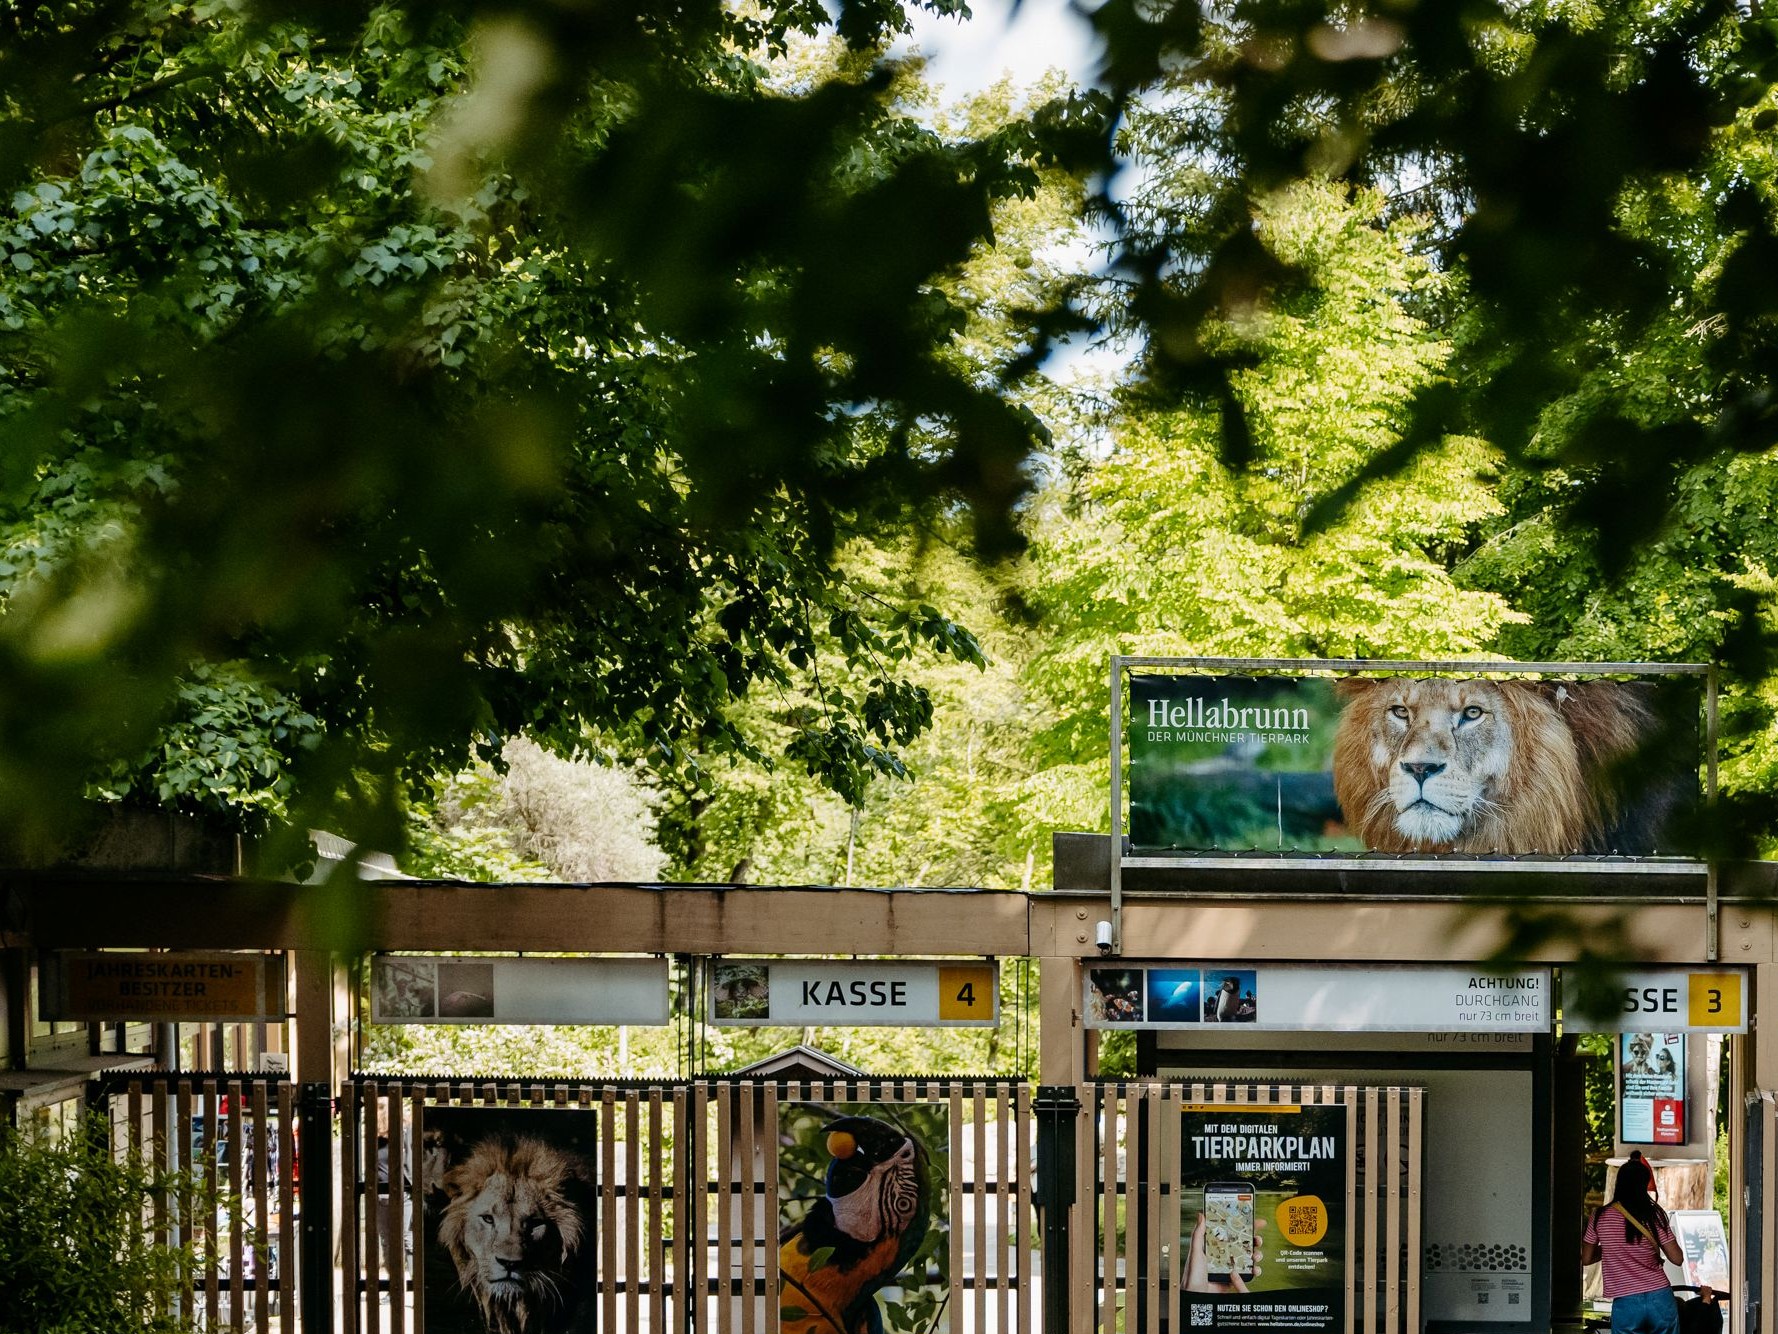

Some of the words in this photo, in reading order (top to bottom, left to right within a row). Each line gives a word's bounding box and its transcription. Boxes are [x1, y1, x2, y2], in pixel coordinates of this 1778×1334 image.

[1147, 697, 1310, 729] Hellabrunn
[1147, 731, 1171, 742] DER
[1176, 730, 1245, 743] MÜNCHNER
[1250, 732, 1310, 744] TIERPARK
[87, 962, 242, 979] JAHRESKARTEN-
[120, 981, 207, 996] BESITZER
[1468, 977, 1539, 989] ACHTUNG!
[802, 980, 907, 1006] KASSE
[956, 982, 976, 1007] 4
[1455, 994, 1539, 1007] DURCHGANG
[1603, 987, 1678, 1013] SSE
[1706, 989, 1722, 1013] 3
[1459, 1012, 1477, 1021] nur
[1479, 1011, 1492, 1021] 73
[1495, 1012, 1511, 1021] cm
[1514, 1011, 1539, 1021] breit
[1204, 1124, 1218, 1133] MIT
[1221, 1124, 1237, 1133] DEM
[1239, 1124, 1278, 1134] DIGITALEN
[1191, 1136, 1335, 1159] TIERPARKPLAN
[1235, 1161, 1261, 1171] IMMER
[1263, 1161, 1311, 1171] INFORMIERT!
[1217, 1304, 1240, 1312] NUTZEN
[1241, 1304, 1251, 1312] SIE
[1253, 1304, 1273, 1312] SCHON
[1274, 1304, 1287, 1312] DEN
[1288, 1304, 1329, 1313] ONLINESHOP?
